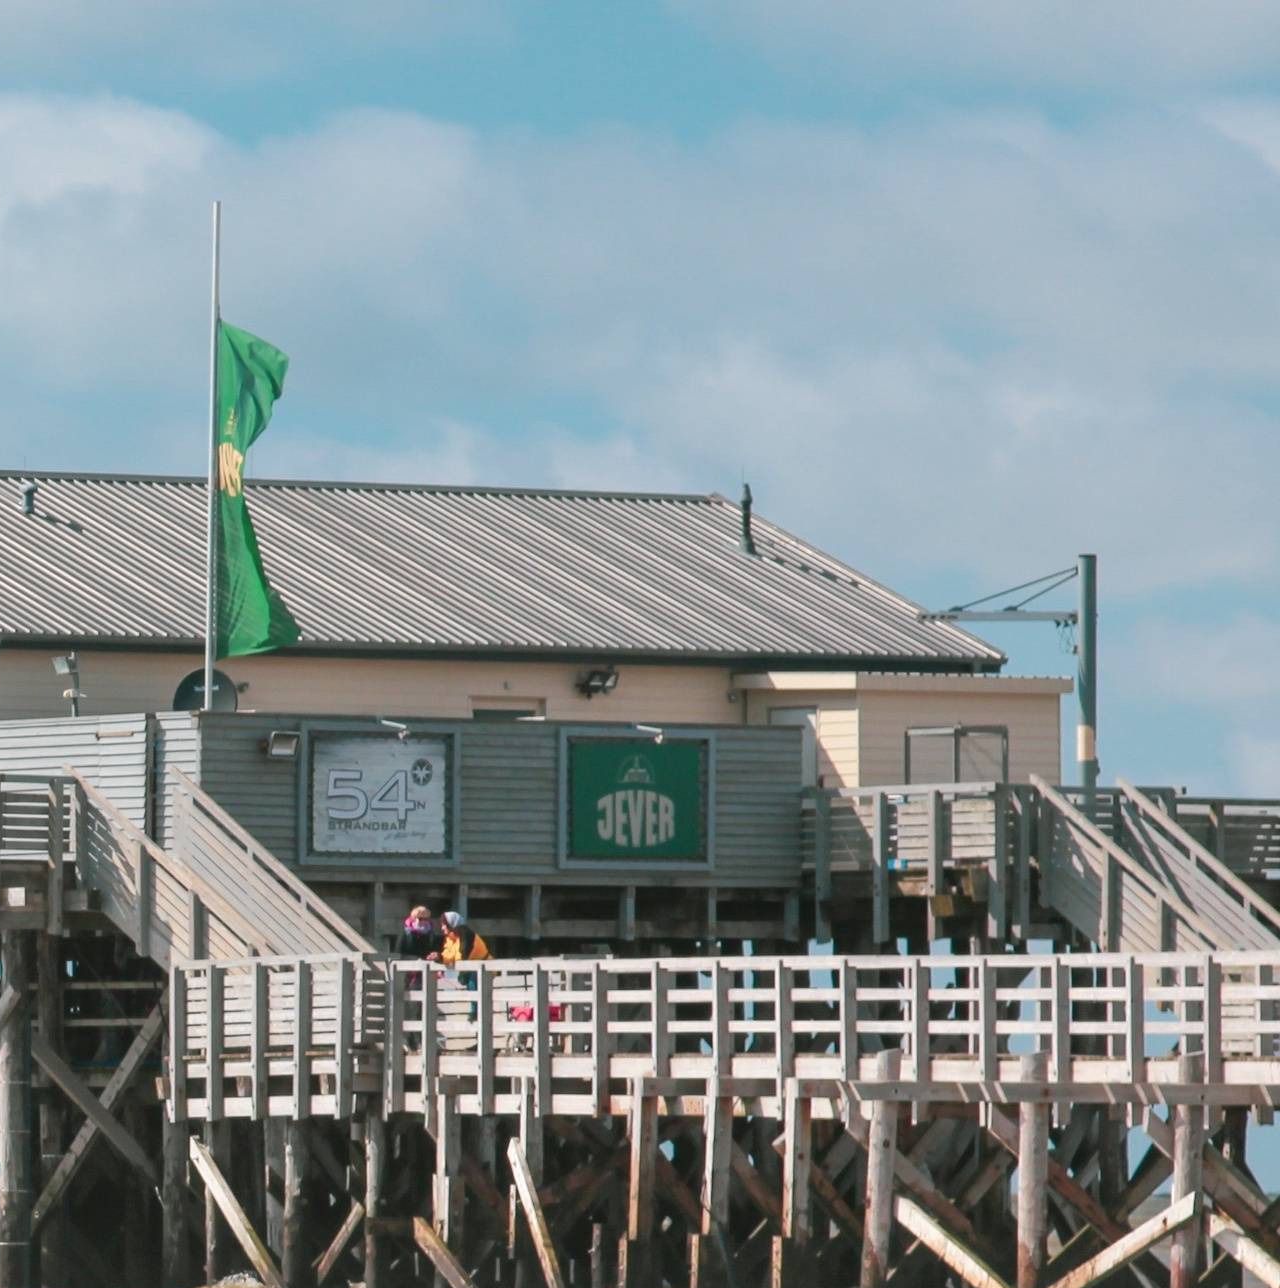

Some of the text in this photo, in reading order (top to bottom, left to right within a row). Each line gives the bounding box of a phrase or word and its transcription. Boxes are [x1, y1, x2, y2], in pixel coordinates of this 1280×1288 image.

[416, 801, 426, 809] N
[596, 789, 676, 848] JEVER
[328, 820, 407, 831] STRANDBAR
